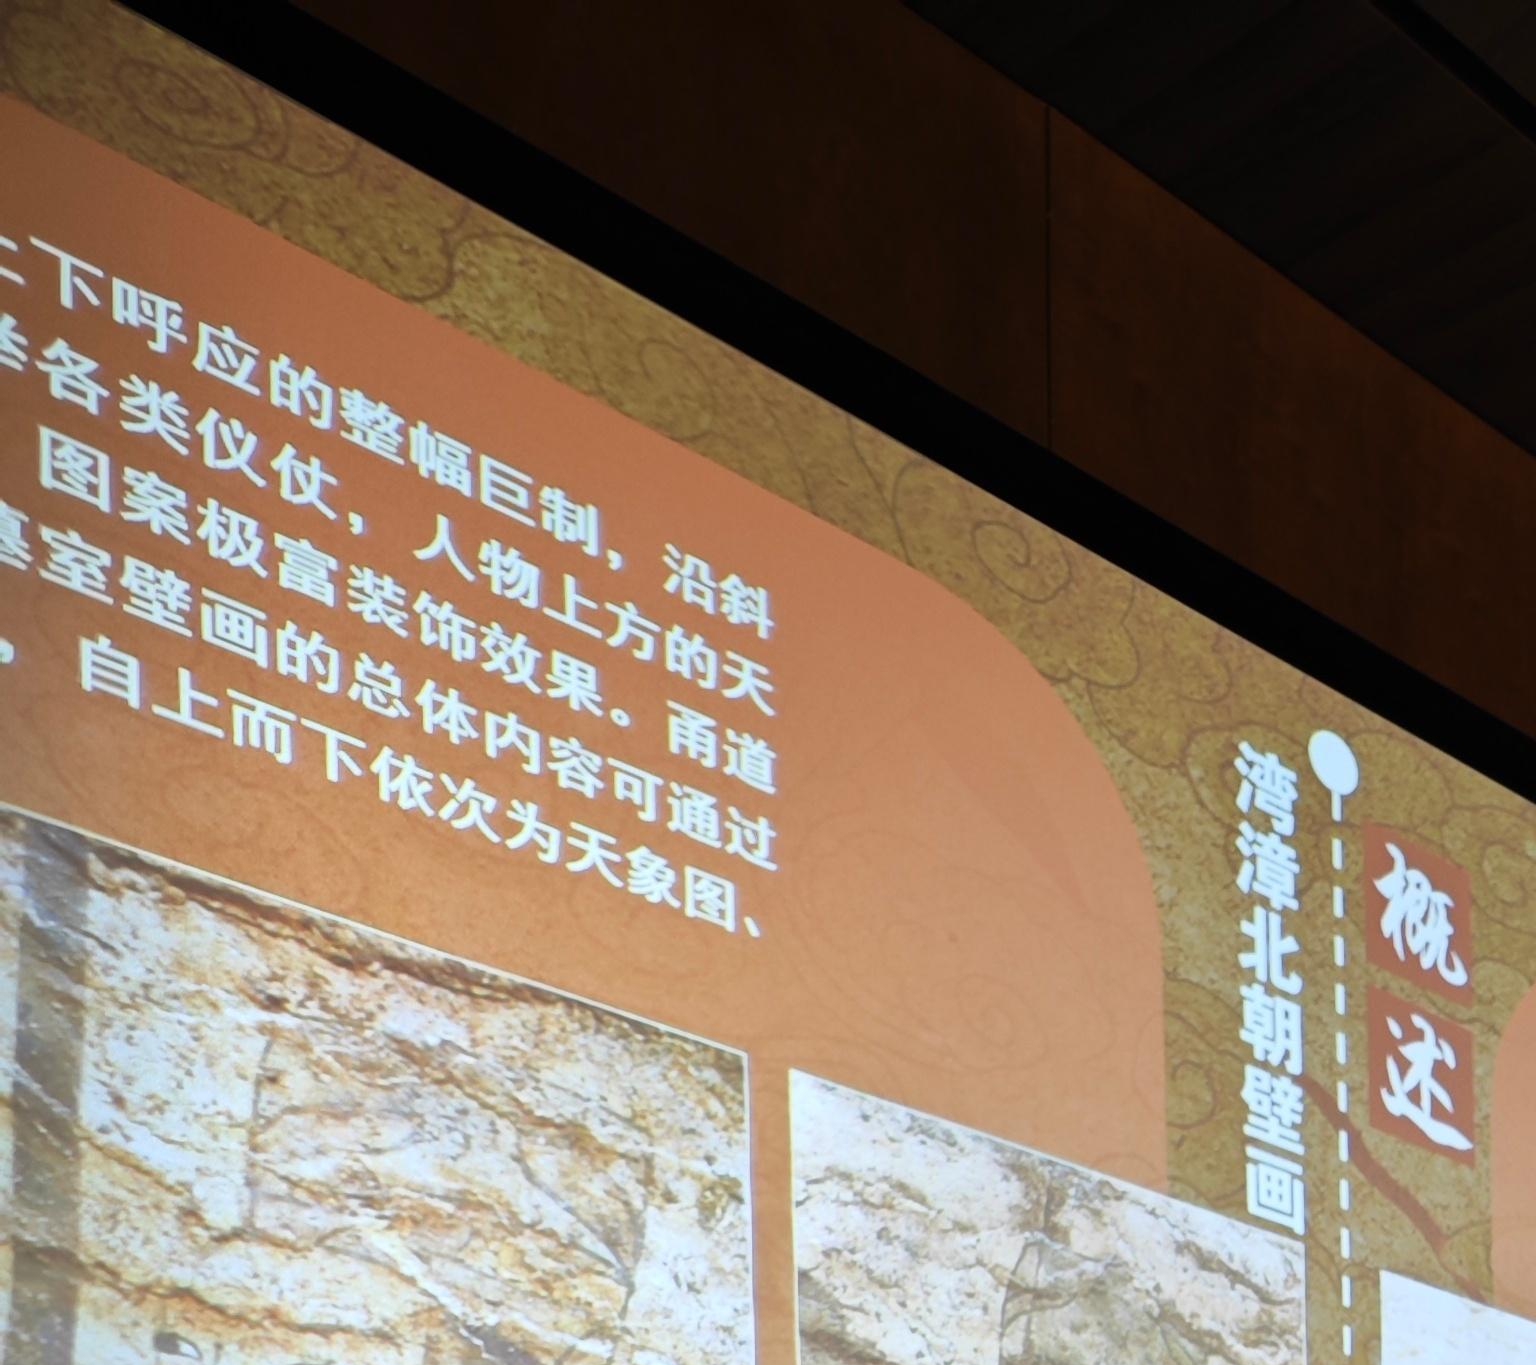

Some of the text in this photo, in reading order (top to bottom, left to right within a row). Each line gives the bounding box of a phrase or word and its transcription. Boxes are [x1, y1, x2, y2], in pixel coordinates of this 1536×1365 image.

[37, 424, 777, 795] 图案极富装饰效果。甬道
[1234, 740, 1305, 1236] 湾漳北朝壁画
